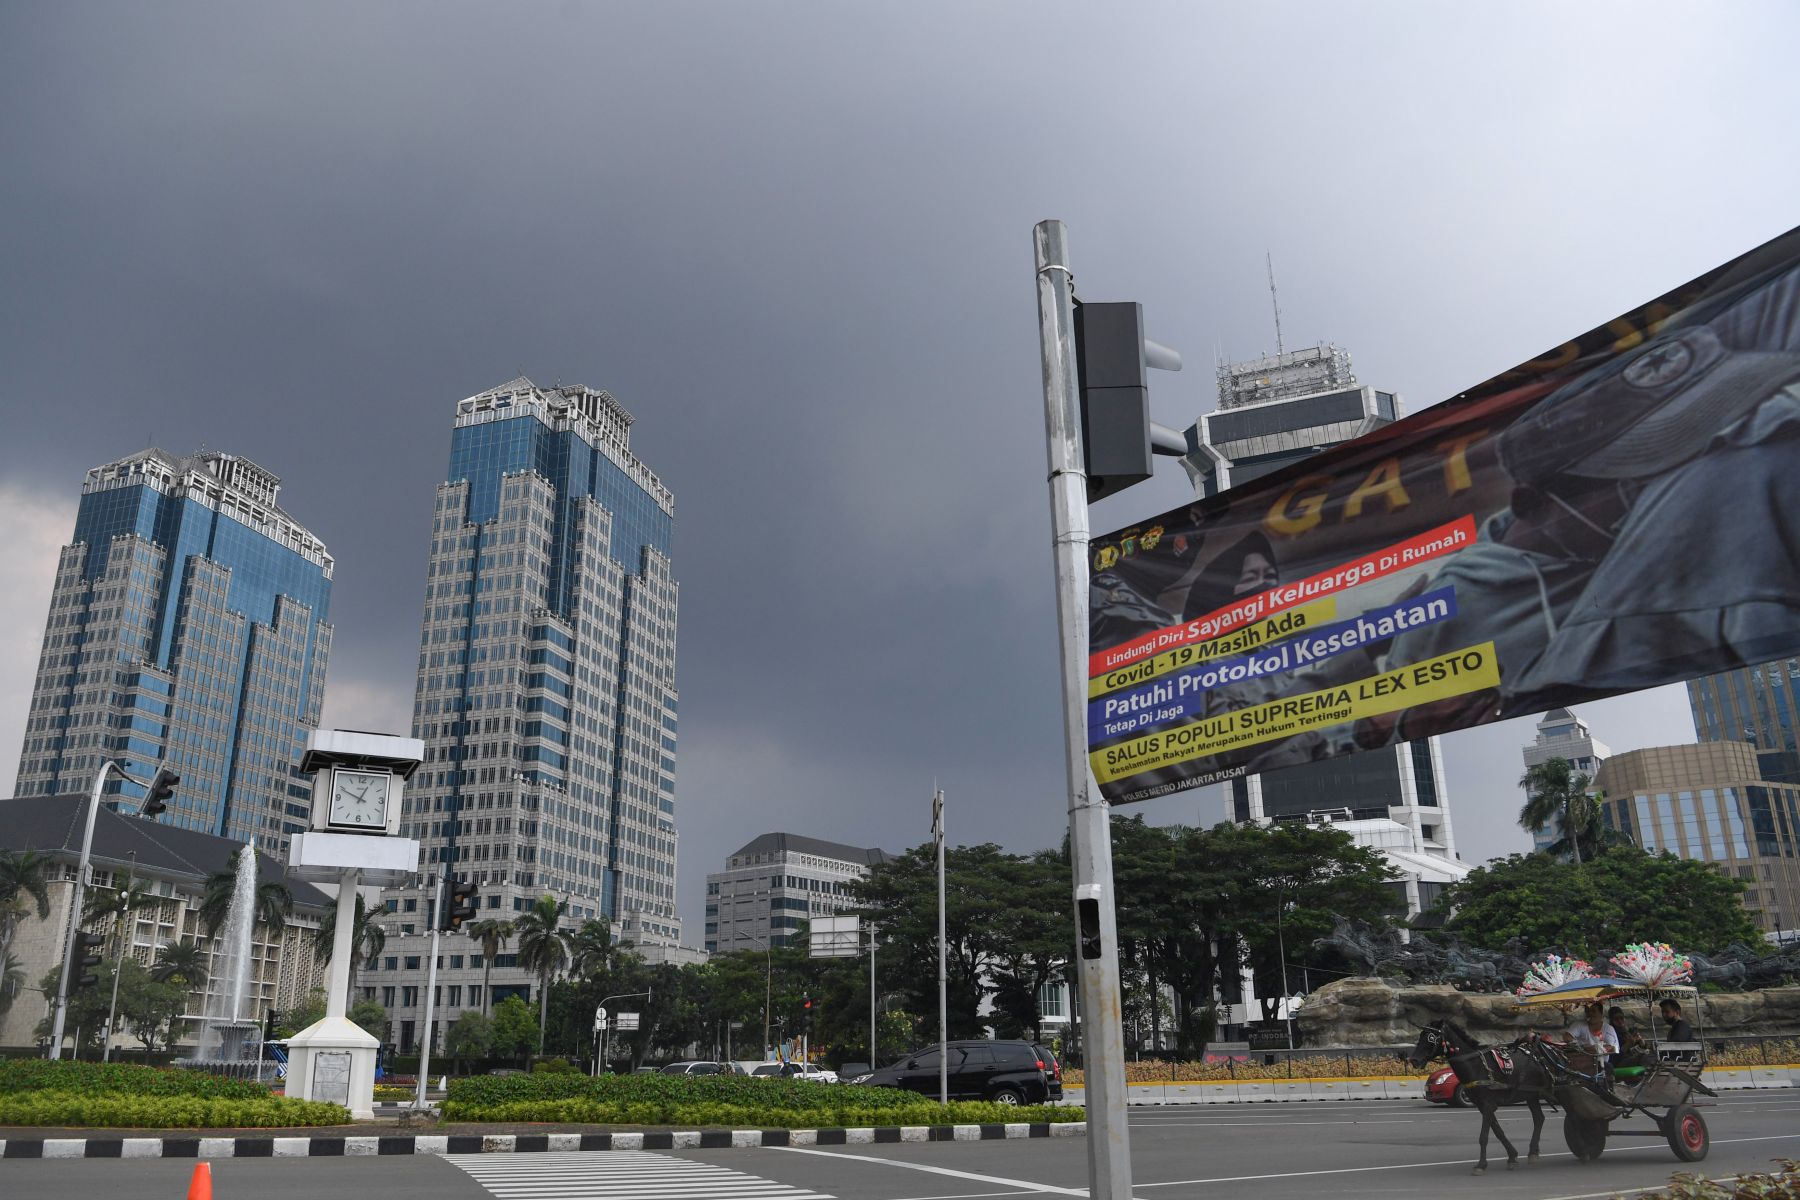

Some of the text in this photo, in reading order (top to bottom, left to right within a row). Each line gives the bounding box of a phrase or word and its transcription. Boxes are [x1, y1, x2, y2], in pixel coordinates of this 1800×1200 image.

[1106, 529, 1466, 666] Lindungi Diri Sayangi Keluarga Di Rumah
[1105, 659, 1154, 689] Covid
[1169, 648, 1193, 667] 19
[1198, 628, 1261, 658] Masih
[1266, 612, 1306, 638] Ada
[1105, 598, 1448, 719] Patuhi Protokol Kesehatan
[1104, 704, 1184, 735] Tetap Di Jaga
[1107, 651, 1483, 765] SALUS POPULI SUPREMA LEX ESTO
[1109, 707, 1352, 776] Keselamatan Rakyat Merupakan Hukum Tertinggi
[358, 776, 367, 784] 12
[1122, 766, 1248, 802] POLRES METRO JAKARTA PUSAT
